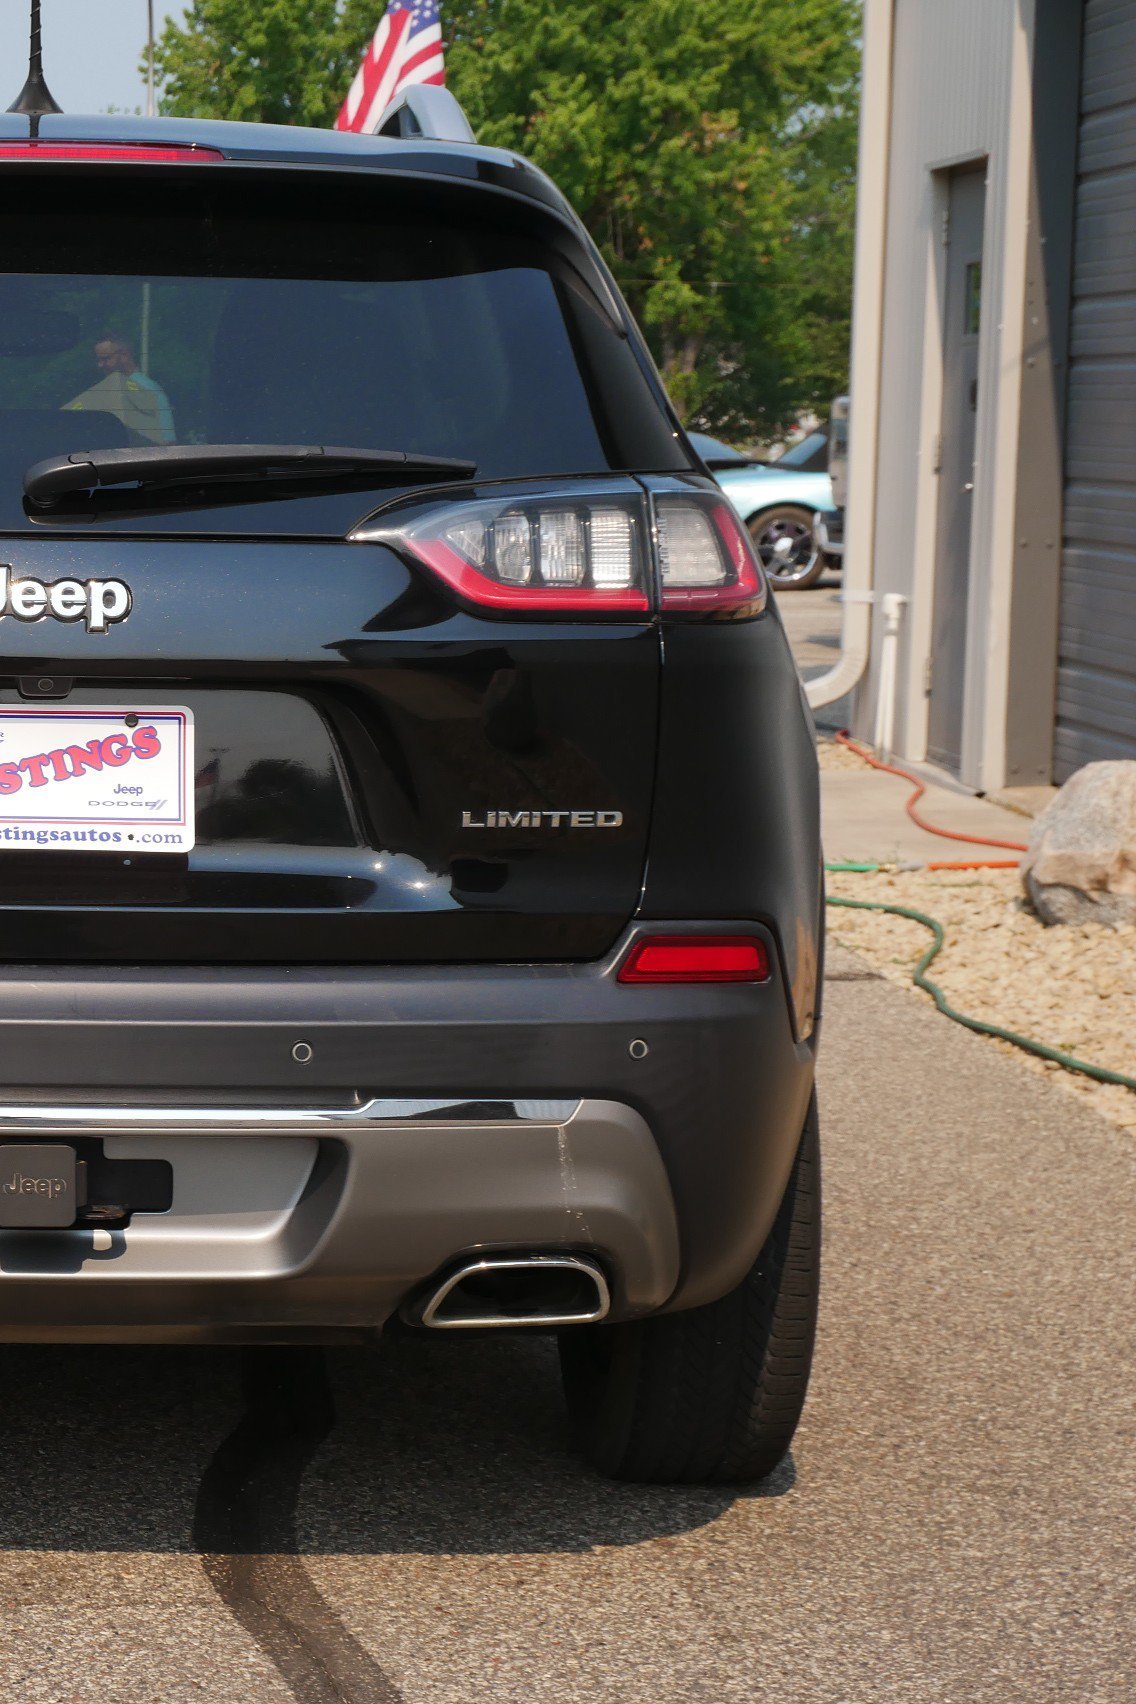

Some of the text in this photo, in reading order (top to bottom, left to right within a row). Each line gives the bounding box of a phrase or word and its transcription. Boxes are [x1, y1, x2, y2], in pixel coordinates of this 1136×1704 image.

[113, 783, 144, 797] Jeep
[461, 810, 624, 828] LIMITED
[3, 1172, 67, 1199] Jeep
